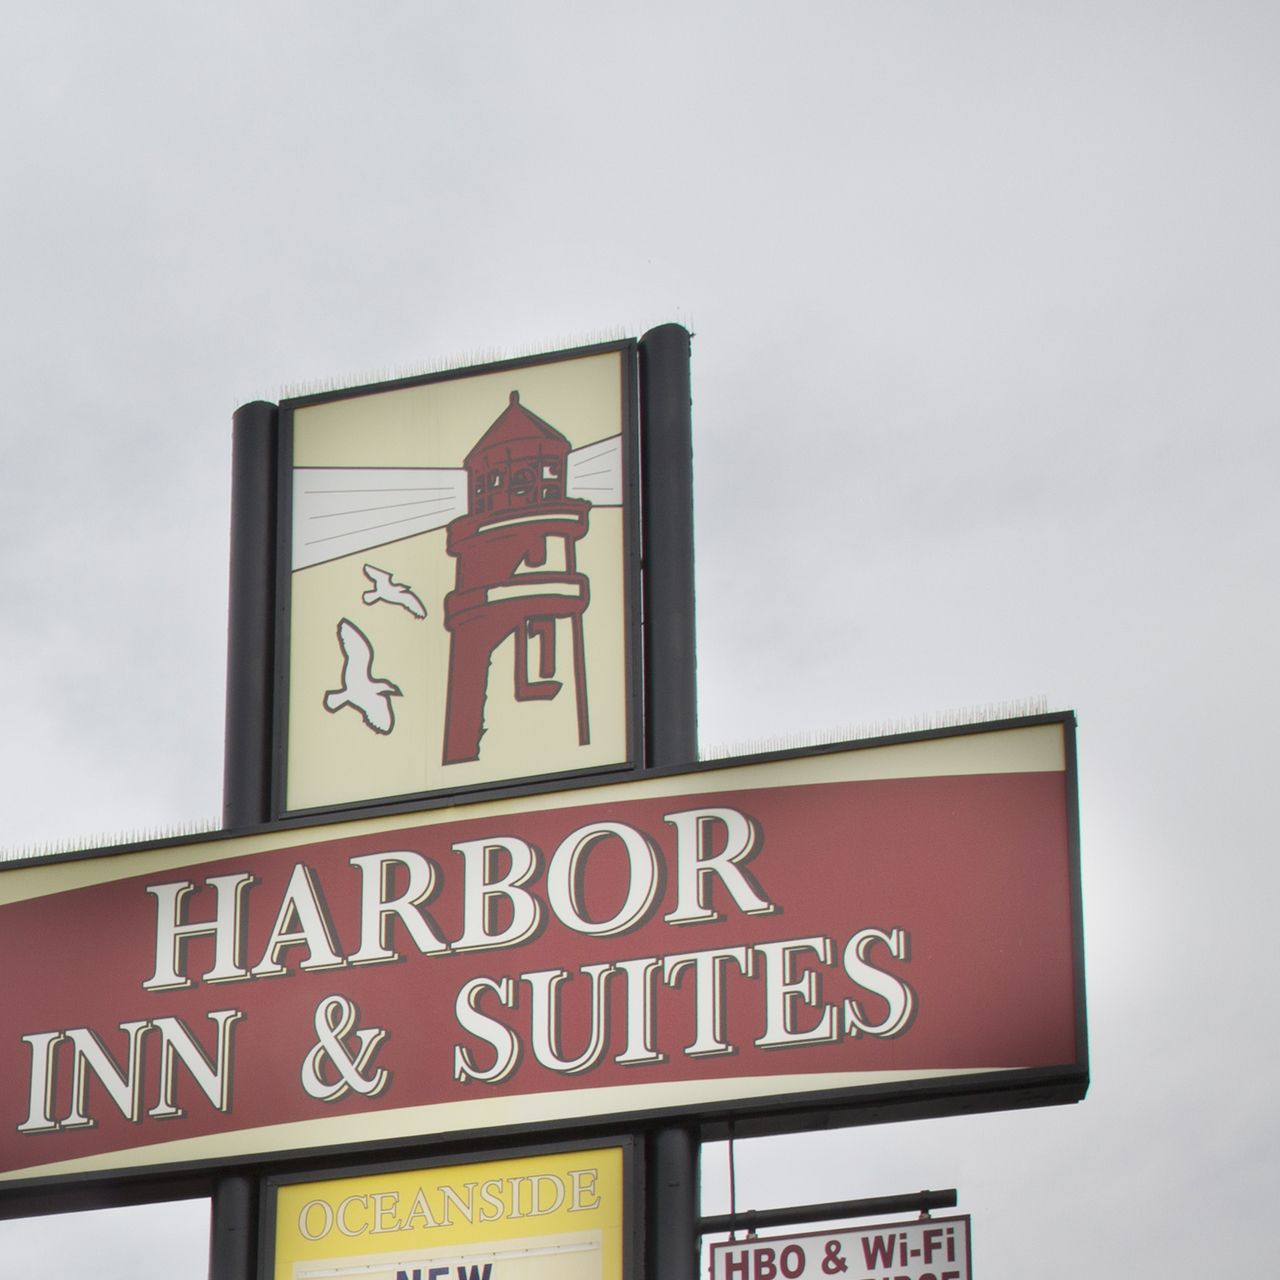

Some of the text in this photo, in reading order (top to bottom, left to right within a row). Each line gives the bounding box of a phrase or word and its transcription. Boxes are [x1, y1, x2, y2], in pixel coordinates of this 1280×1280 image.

[142, 806, 776, 993] HARBOR
[17, 927, 916, 1134] INN & SUITES
[298, 1168, 601, 1241] OCEANSIDE
[821, 1239, 848, 1275] &
[861, 1227, 956, 1271] Wi-Fi
